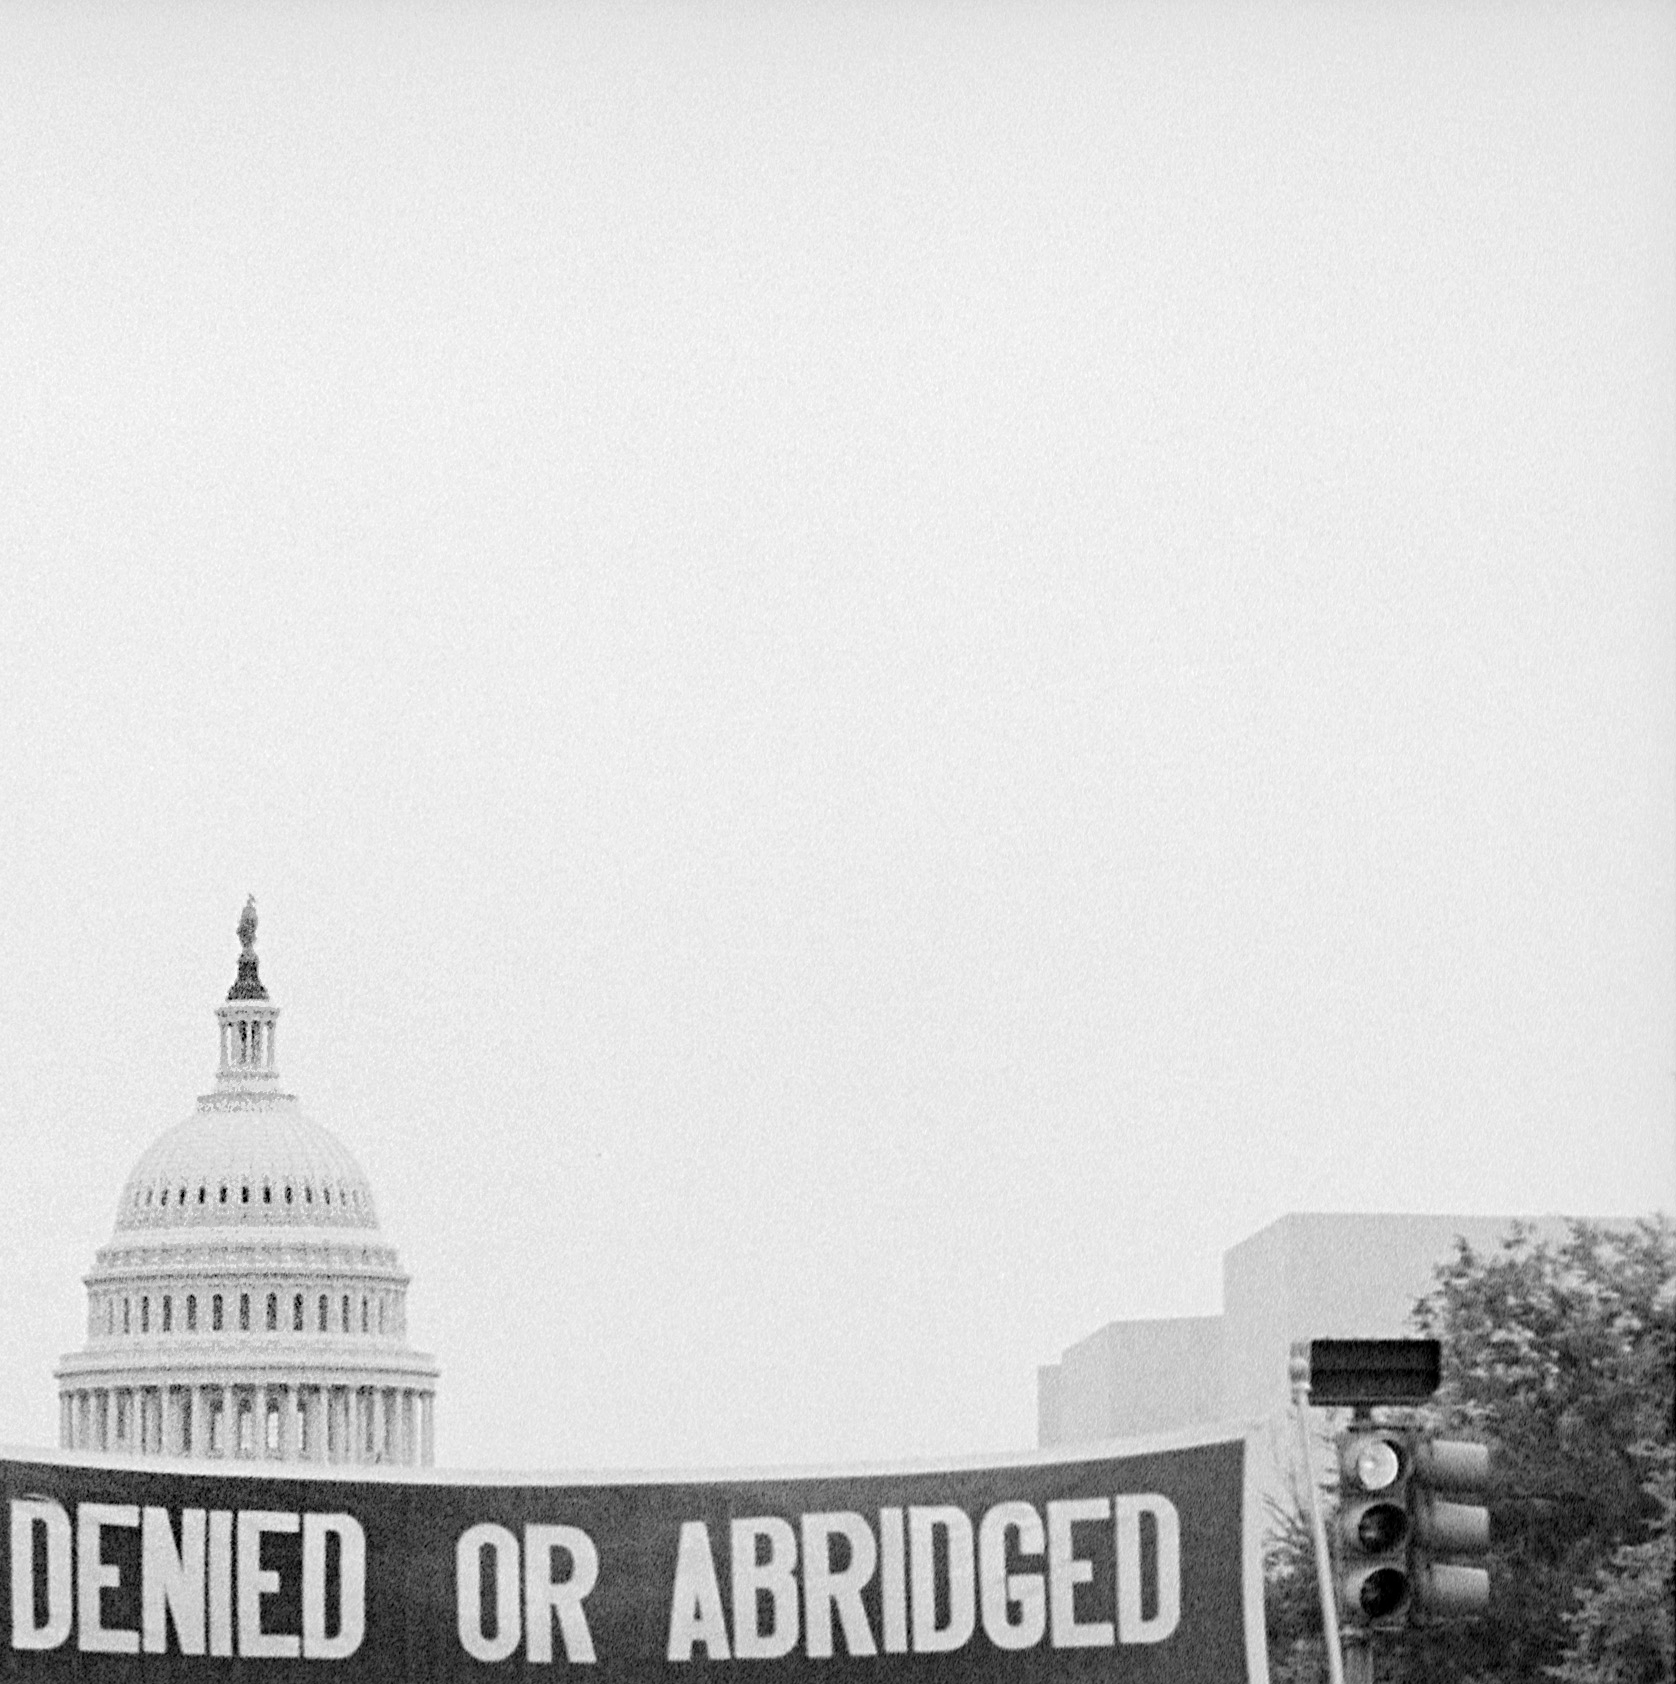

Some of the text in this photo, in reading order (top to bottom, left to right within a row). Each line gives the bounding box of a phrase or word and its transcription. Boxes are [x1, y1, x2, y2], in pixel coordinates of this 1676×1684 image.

[8, 1492, 367, 1660] DENIED
[455, 1521, 600, 1665] OR
[667, 1491, 1182, 1662] ABRIDGED
